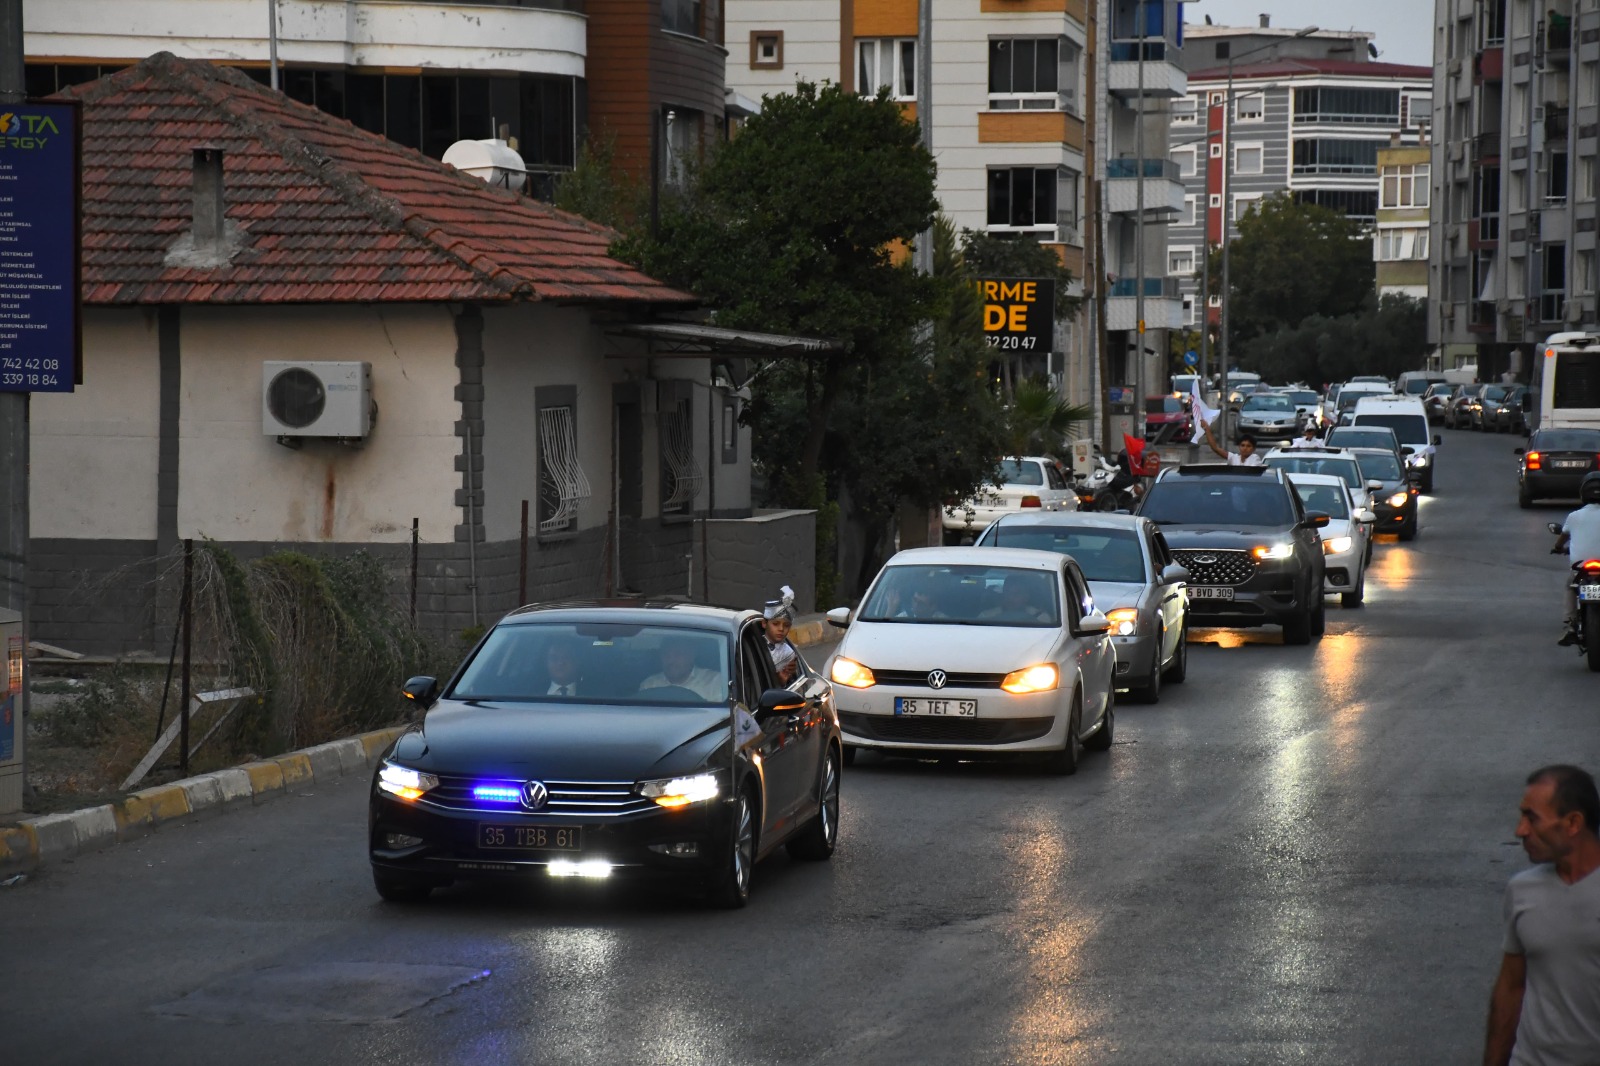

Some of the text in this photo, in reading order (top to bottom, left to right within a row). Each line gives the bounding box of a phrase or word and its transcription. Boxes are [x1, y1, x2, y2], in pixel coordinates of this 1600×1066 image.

[983, 304, 1028, 331] DE
[1002, 336, 1019, 349] 20
[1021, 337, 1037, 350] 47
[2, 358, 59, 370] 742 42 08
[2, 373, 58, 386] 339 18 84
[1196, 588, 1213, 598] BVD
[1216, 588, 1233, 598] 309
[902, 700, 974, 716] 35 TET 52
[485, 827, 574, 848] 35 TBB 61
